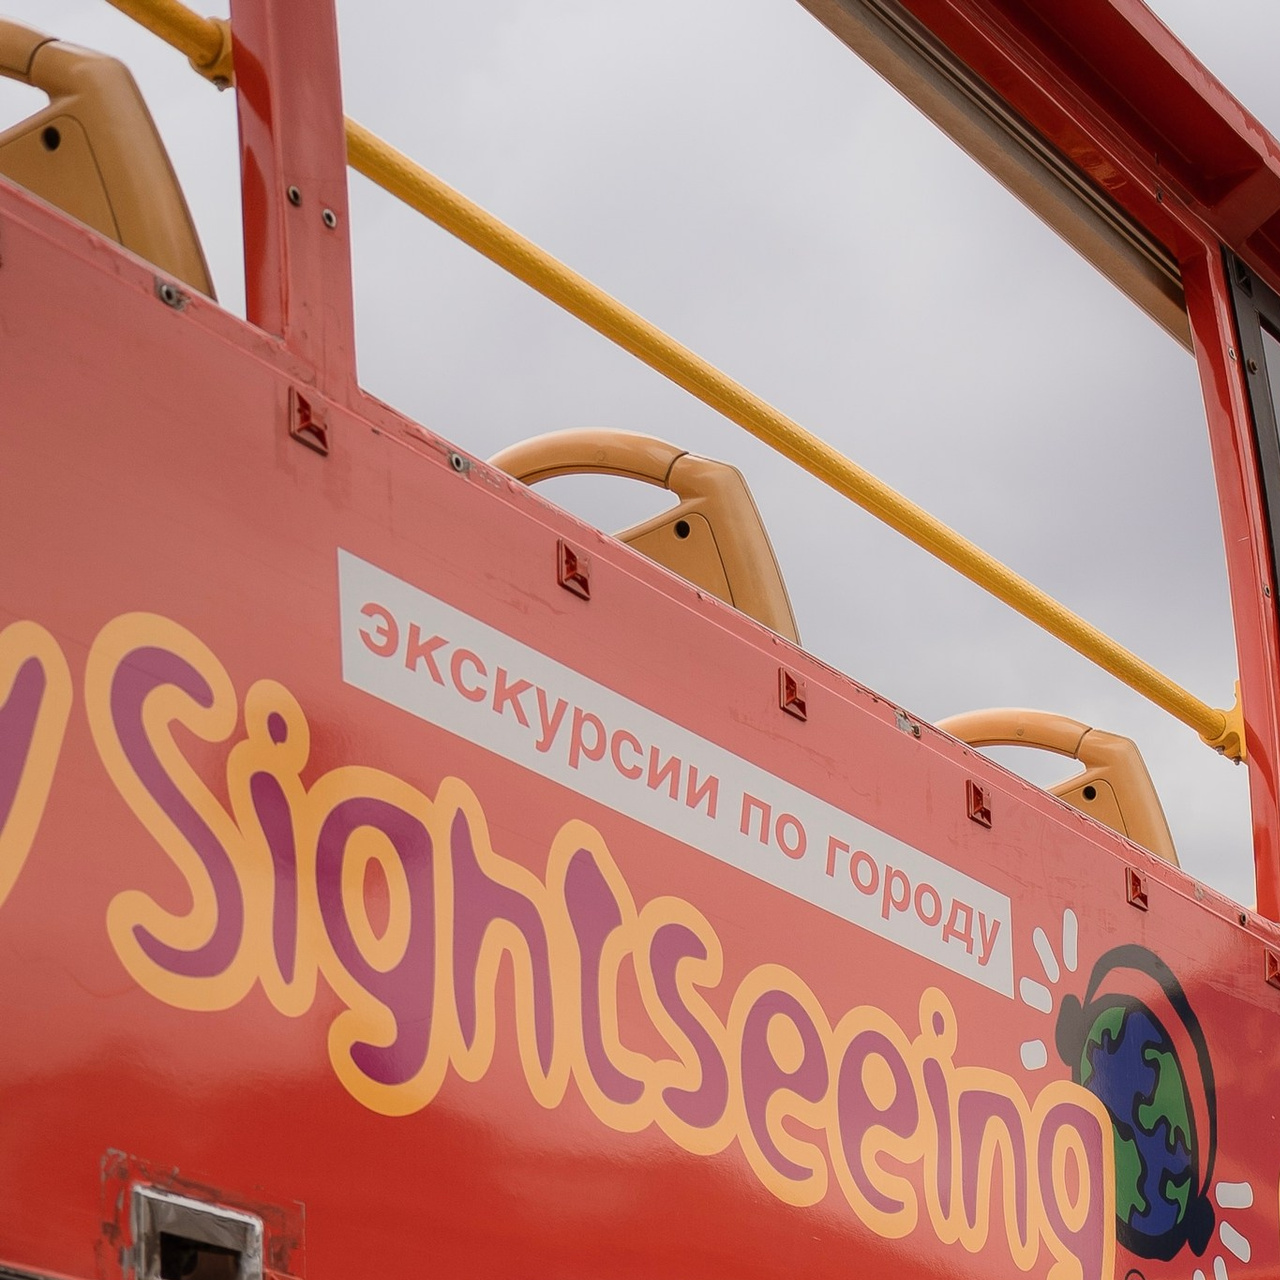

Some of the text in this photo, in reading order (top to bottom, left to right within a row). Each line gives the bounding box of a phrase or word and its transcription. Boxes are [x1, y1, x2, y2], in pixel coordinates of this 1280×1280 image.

[357, 602, 1001, 966] экскурсии по городу
